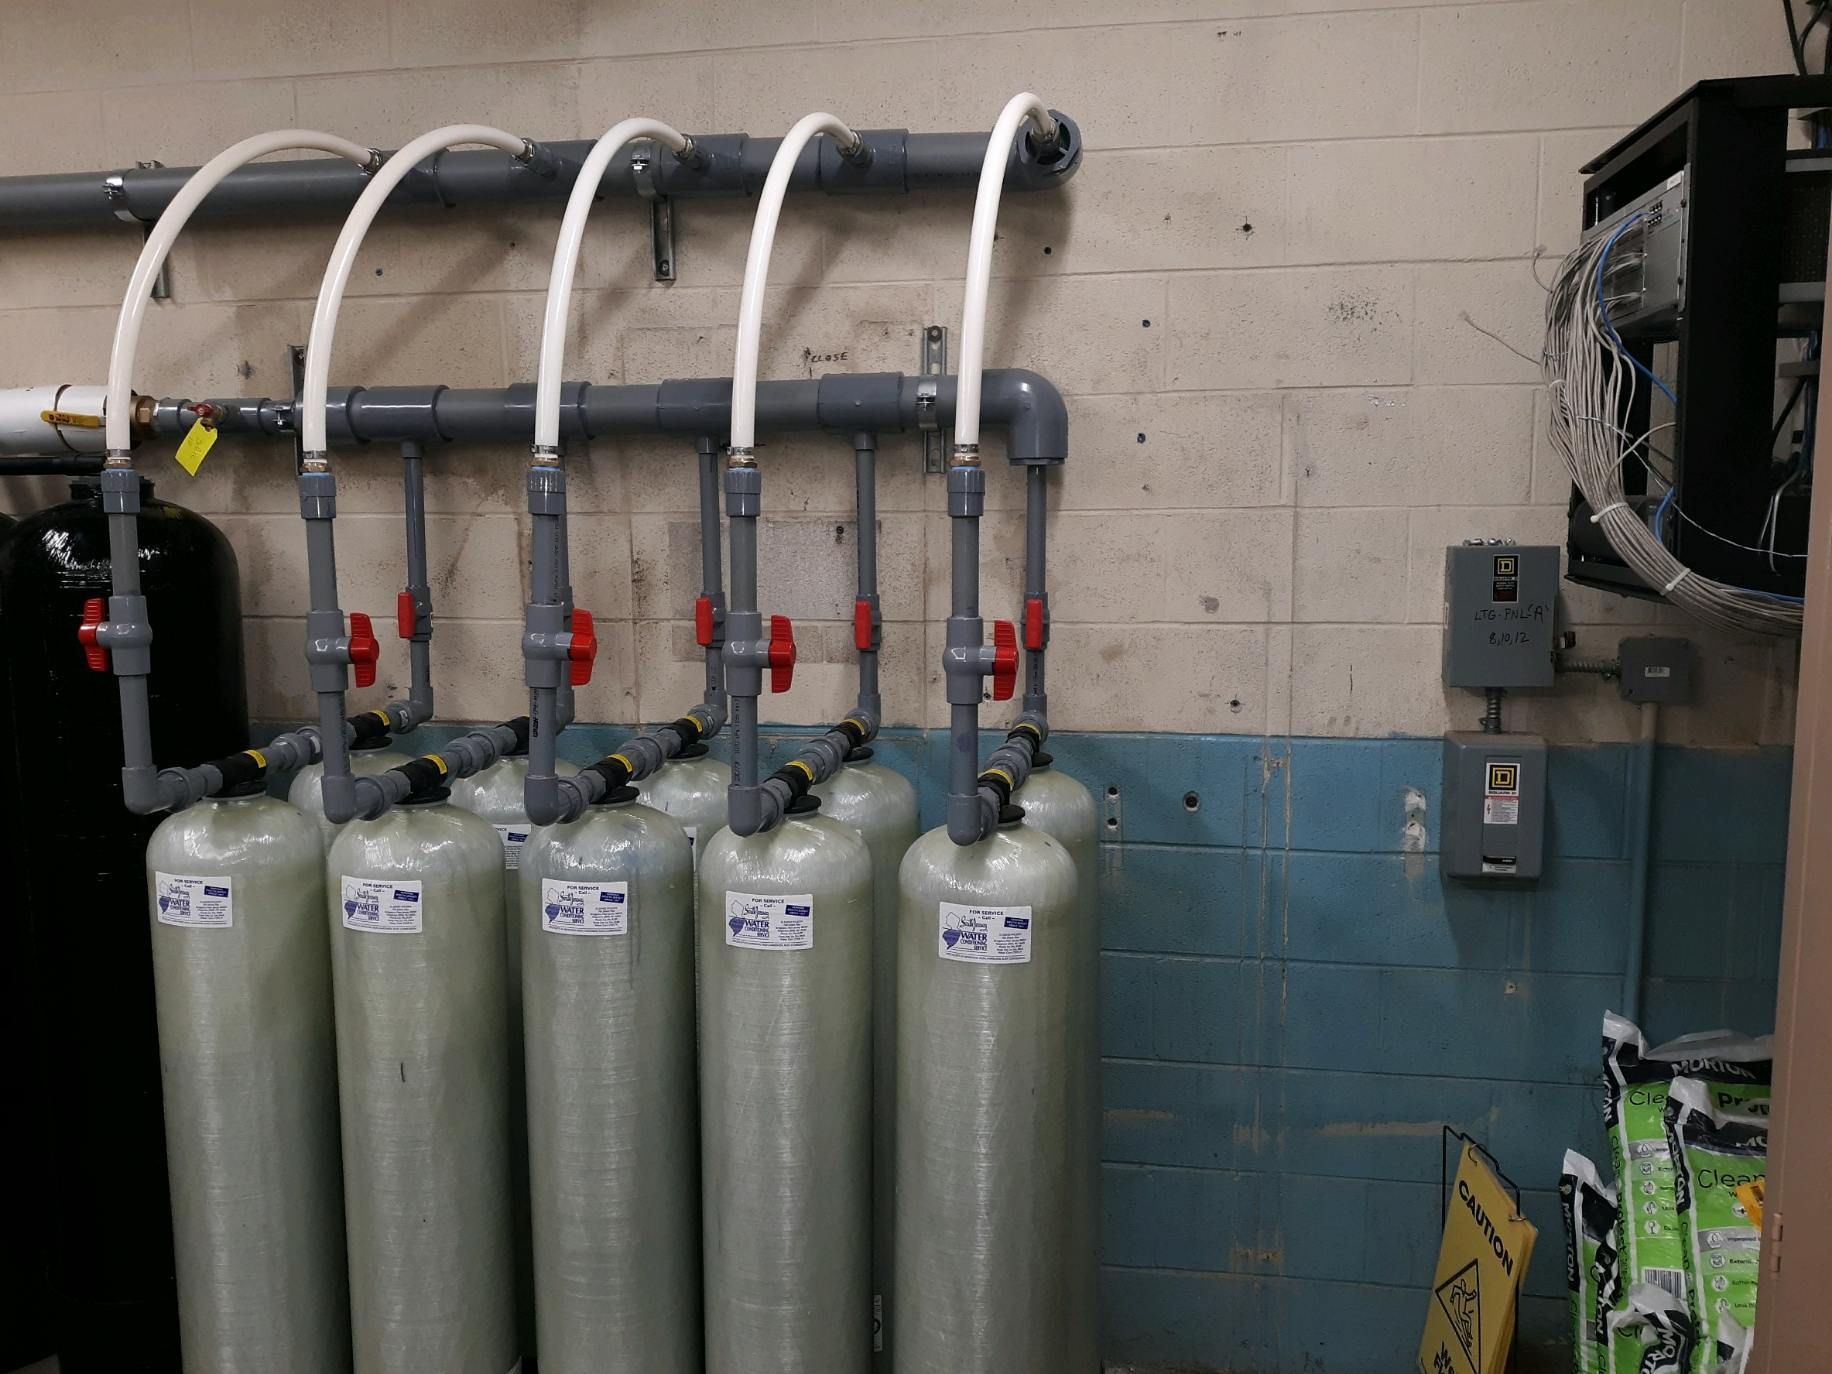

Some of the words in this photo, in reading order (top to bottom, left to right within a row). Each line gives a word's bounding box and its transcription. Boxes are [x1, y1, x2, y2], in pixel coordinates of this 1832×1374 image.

[811, 351, 849, 363] CLOSE
[358, 903, 379, 912] WATER
[560, 906, 584, 914] WATER
[744, 918, 769, 928] WATER
[960, 931, 987, 941] WATER
[1629, 1091, 1668, 1106] Cle
[1458, 1180, 1514, 1277] CAUTION
